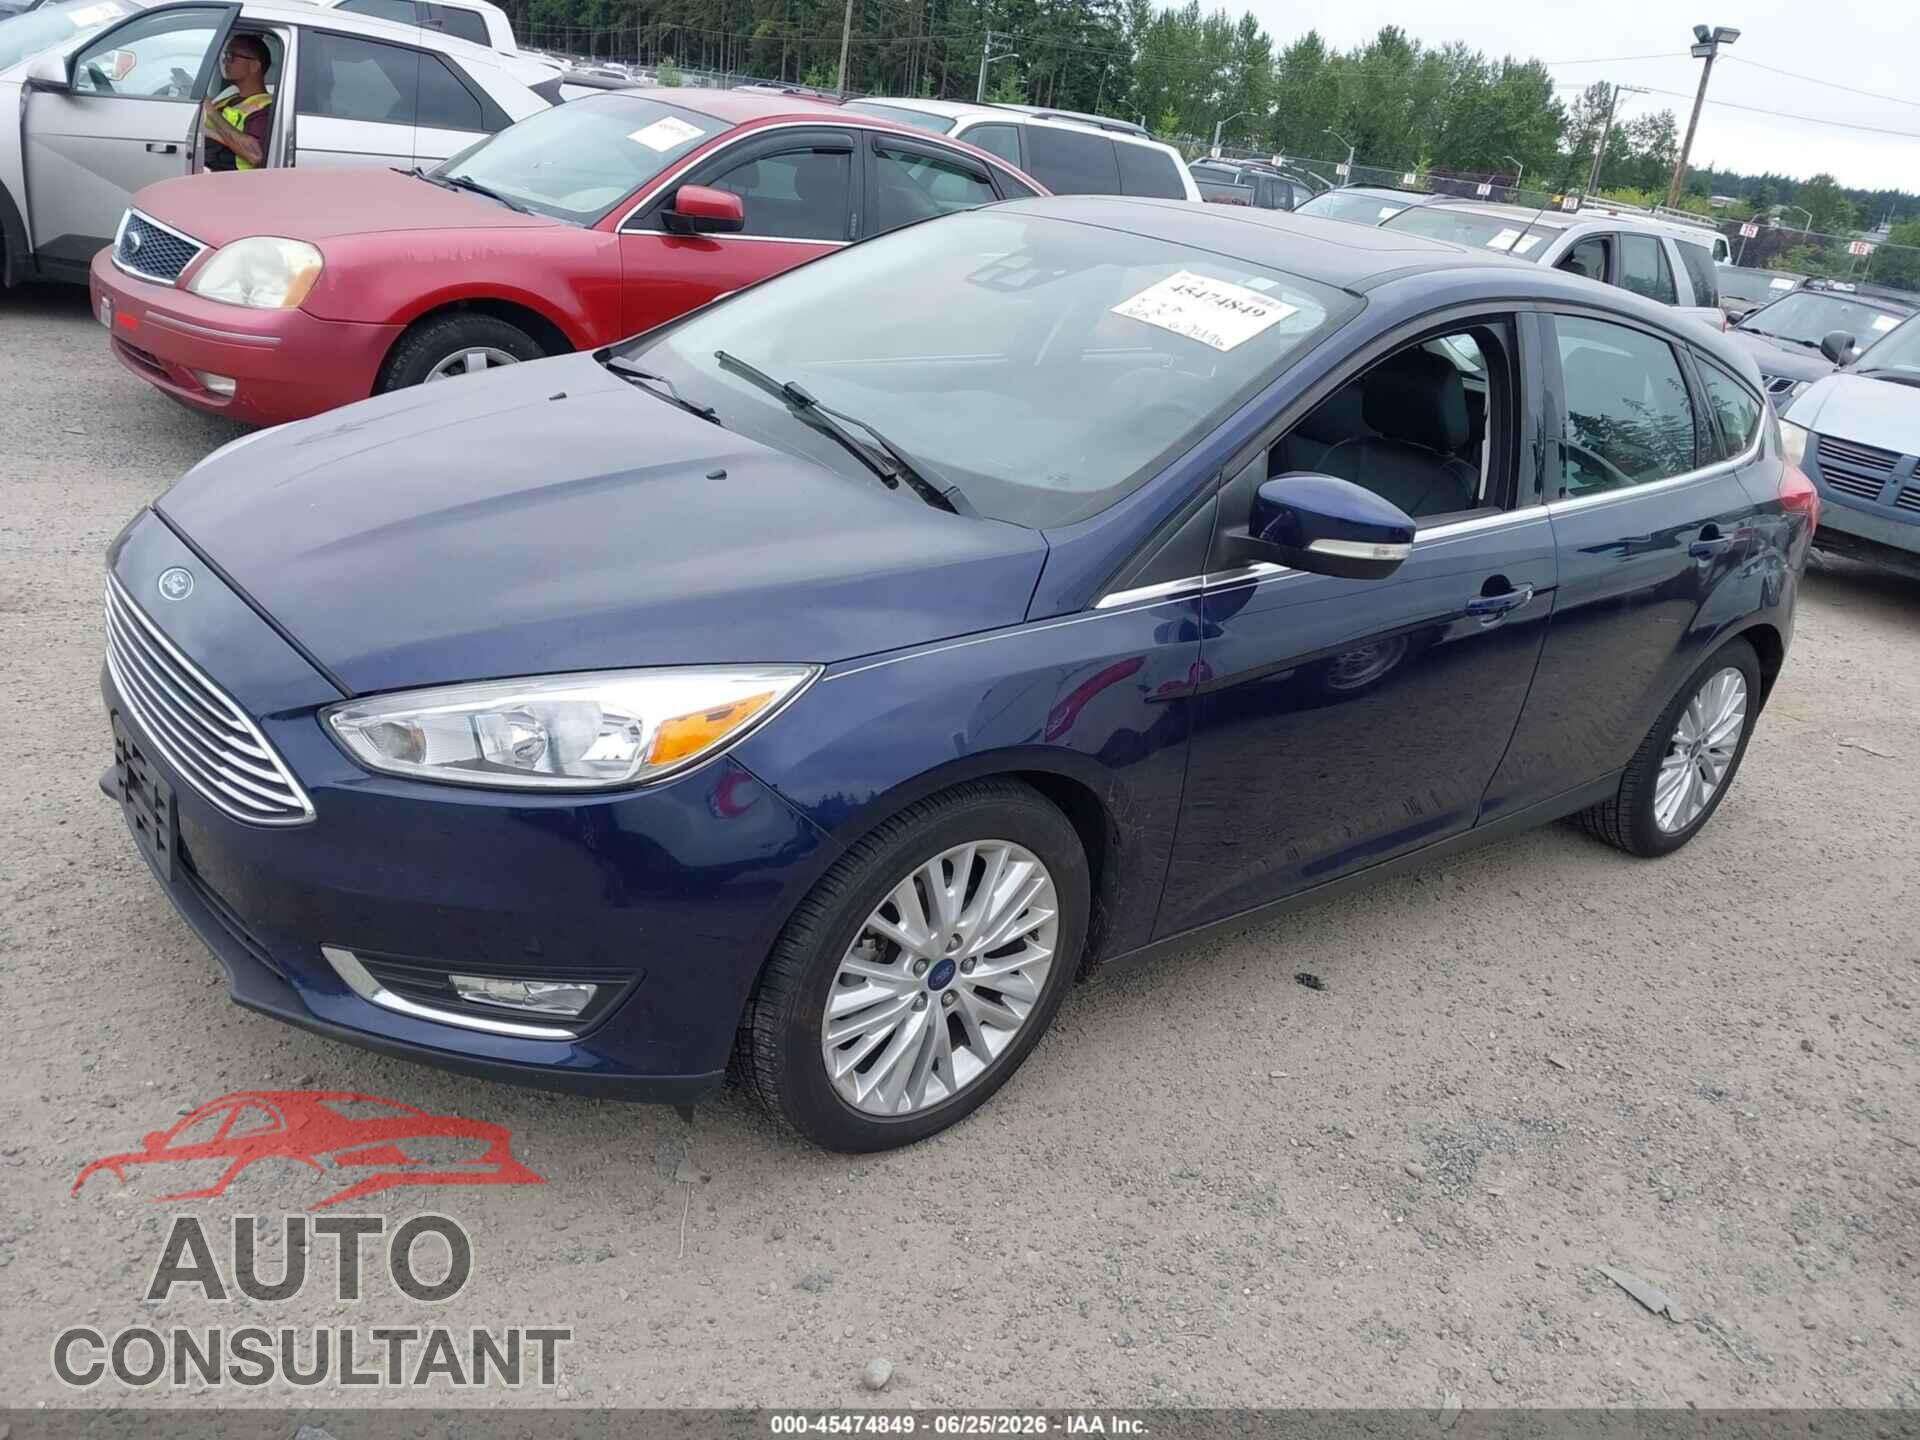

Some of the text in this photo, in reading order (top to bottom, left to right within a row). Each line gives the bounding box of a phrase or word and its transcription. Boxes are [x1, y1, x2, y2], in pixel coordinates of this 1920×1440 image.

[1743, 223, 1755, 236] 15
[1853, 241, 1866, 254] 16
[1170, 284, 1267, 317] 45474849
